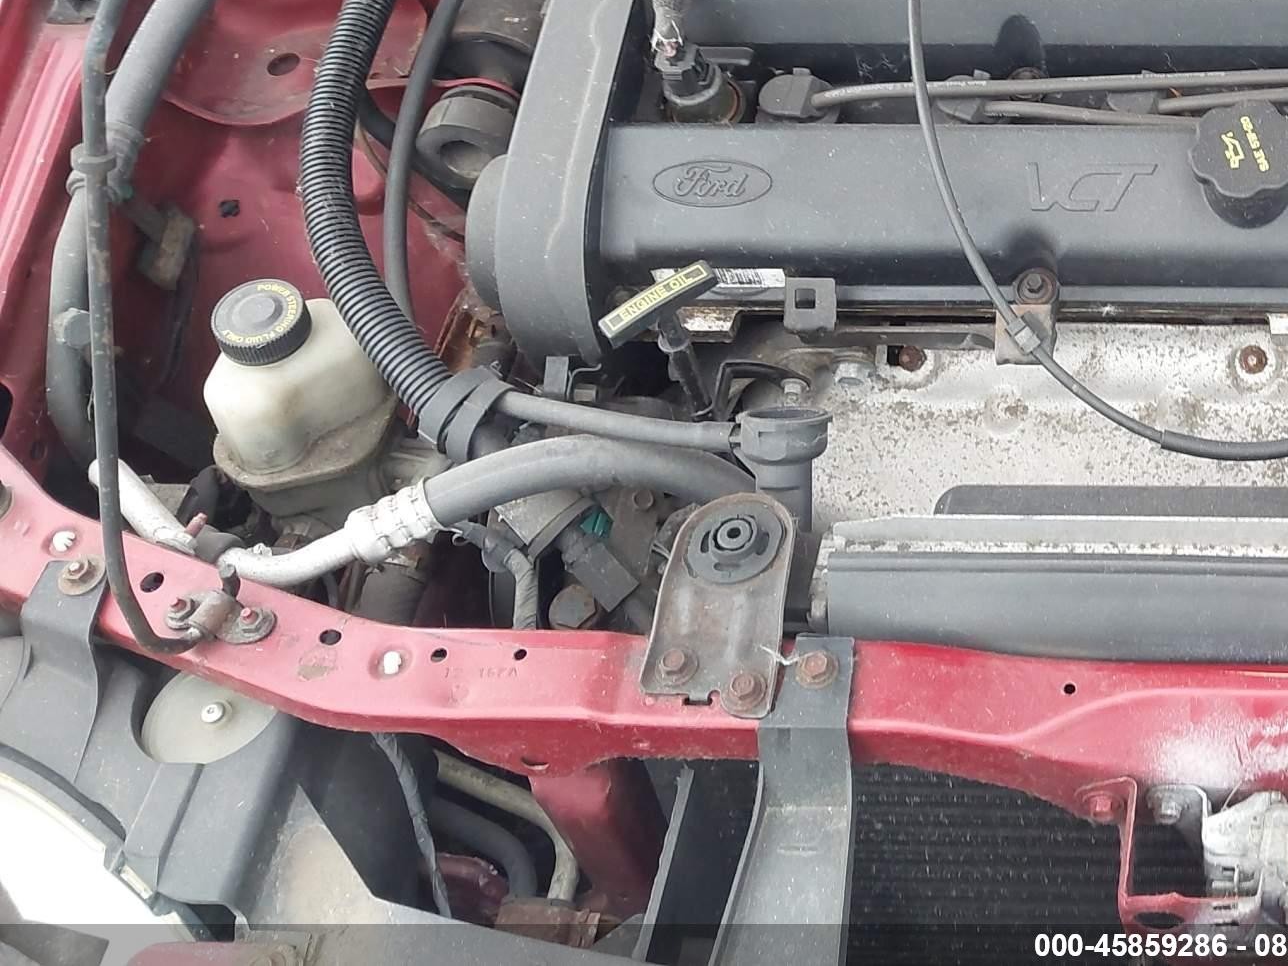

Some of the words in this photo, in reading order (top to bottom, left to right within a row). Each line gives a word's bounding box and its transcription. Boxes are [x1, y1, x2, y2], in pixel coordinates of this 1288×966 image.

[1240, 116, 1260, 149] 5W-20
[1253, 149, 1270, 172] SAE
[673, 165, 750, 197] Ford
[1026, 162, 1159, 212] VCT
[256, 283, 291, 296] POWER
[619, 286, 667, 320] ENGINE
[668, 275, 694, 291] OIL
[275, 295, 298, 332] STEERING
[221, 328, 244, 343] ONLY
[245, 331, 276, 344] FLUID
